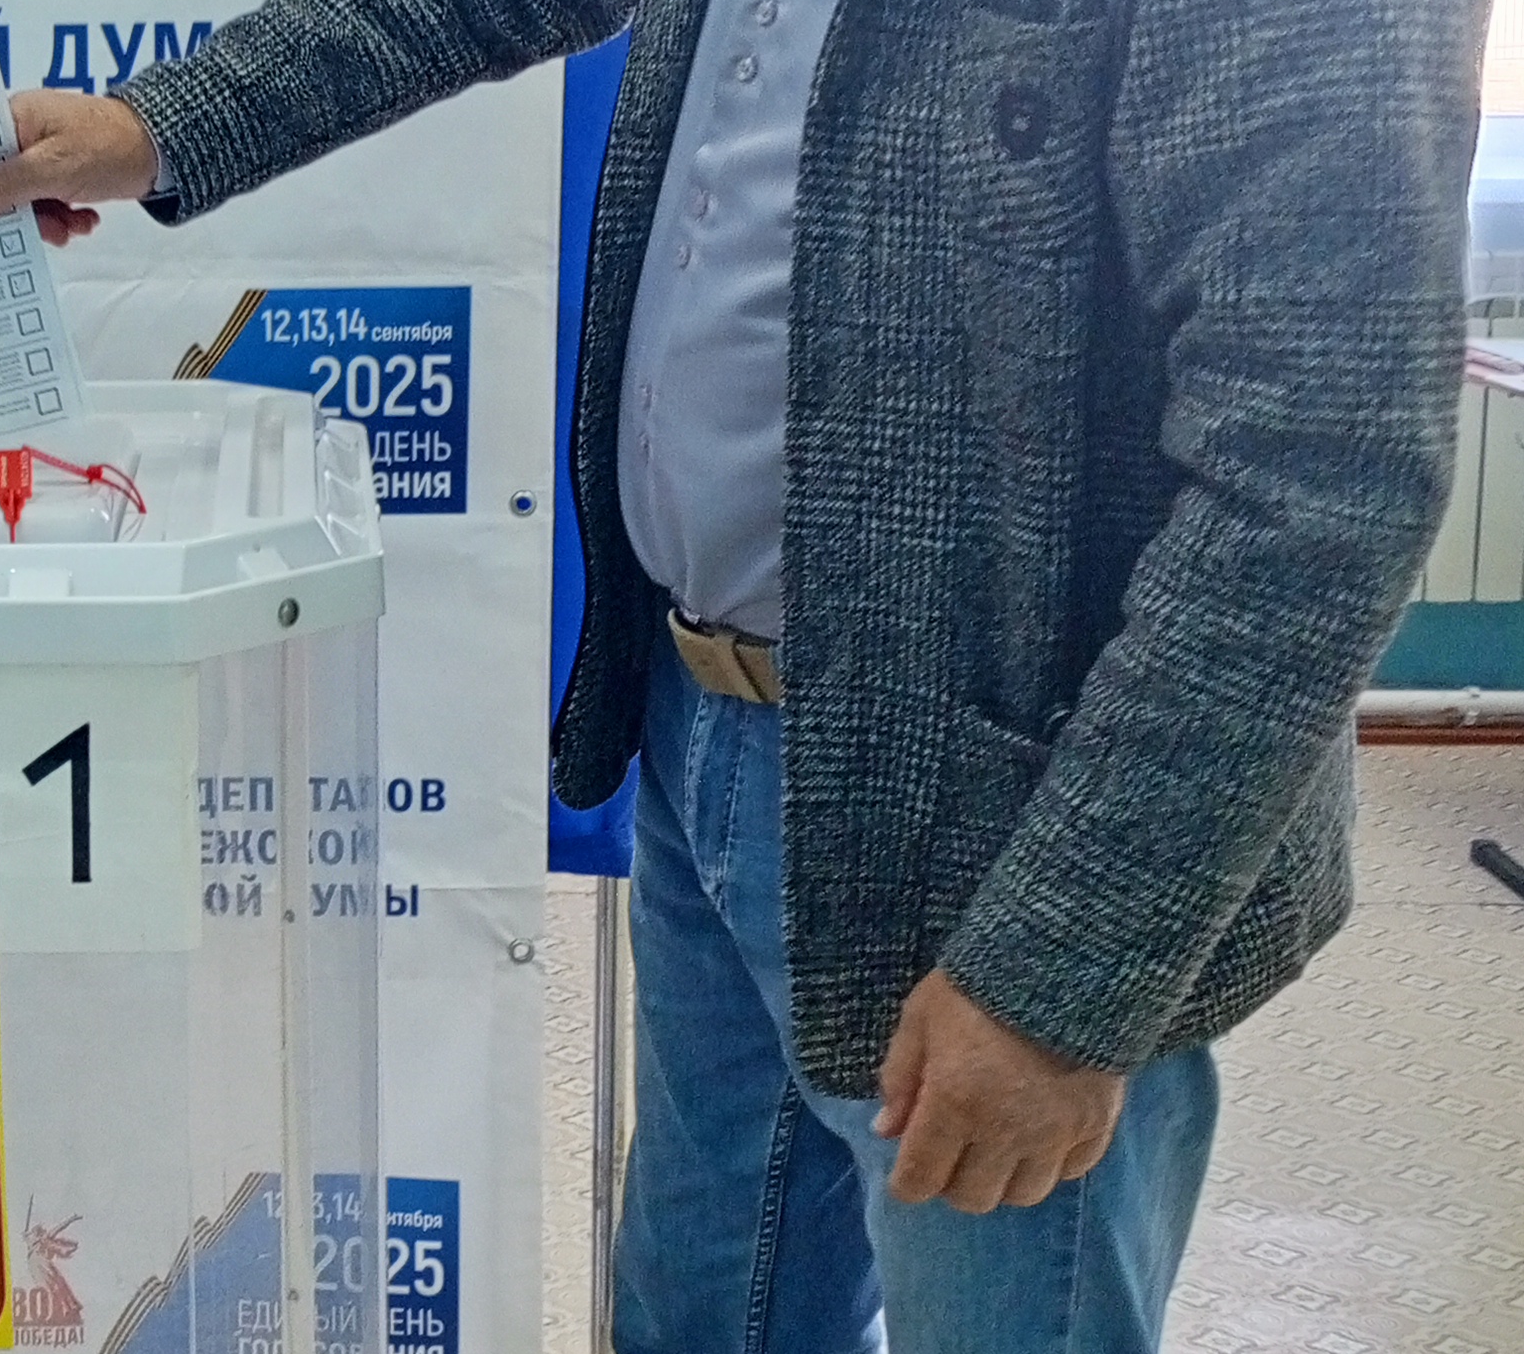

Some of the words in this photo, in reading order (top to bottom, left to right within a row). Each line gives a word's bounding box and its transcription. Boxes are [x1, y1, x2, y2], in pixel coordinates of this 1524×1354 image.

[43, 21, 213, 94] ДУМ
[261, 308, 368, 347] 12,13,14
[371, 321, 453, 345] сентября
[310, 354, 454, 417] 2025
[371, 431, 452, 467] ДЕНЬ
[22, 722, 91, 883] 1
[314, 1234, 445, 1296] 2025
[389, 1308, 444, 1337] ЕНЬ
